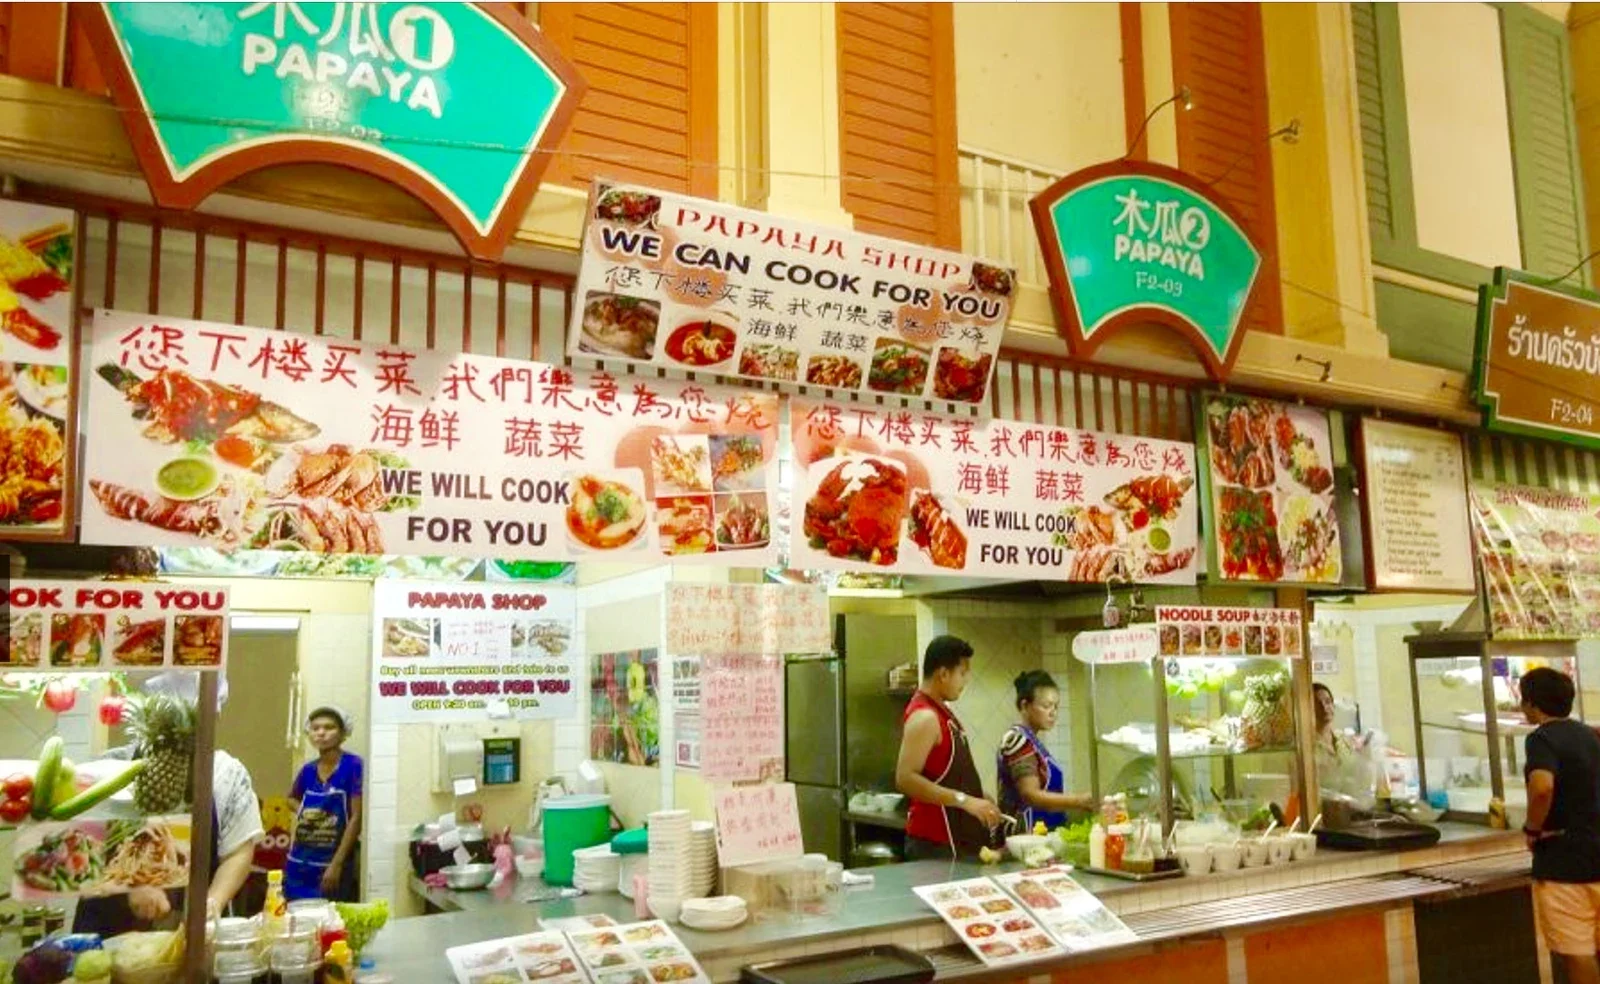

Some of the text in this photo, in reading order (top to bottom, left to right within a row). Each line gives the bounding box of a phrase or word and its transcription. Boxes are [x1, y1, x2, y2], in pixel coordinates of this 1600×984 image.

[243, 33, 442, 118] PAPAYA
[676, 208, 961, 278] PAPAYA SHOP
[1115, 234, 1204, 281] PAPAYA
[602, 228, 1000, 318] WE CAN COOK FOR YOU
[382, 469, 570, 504] WE WILL COOK
[407, 516, 547, 546] FOR YOU
[966, 508, 1076, 533] WE WILL COOK
[980, 544, 1063, 566] FOR YOU
[76, 589, 143, 609] FOR
[155, 590, 225, 610] YOU
[408, 591, 547, 610] PAPAYA SHOP
[1160, 609, 1212, 621] NOODLE
[1217, 610, 1250, 622] SOUP
[379, 680, 570, 696] WE WILL COOK FOR YOU
